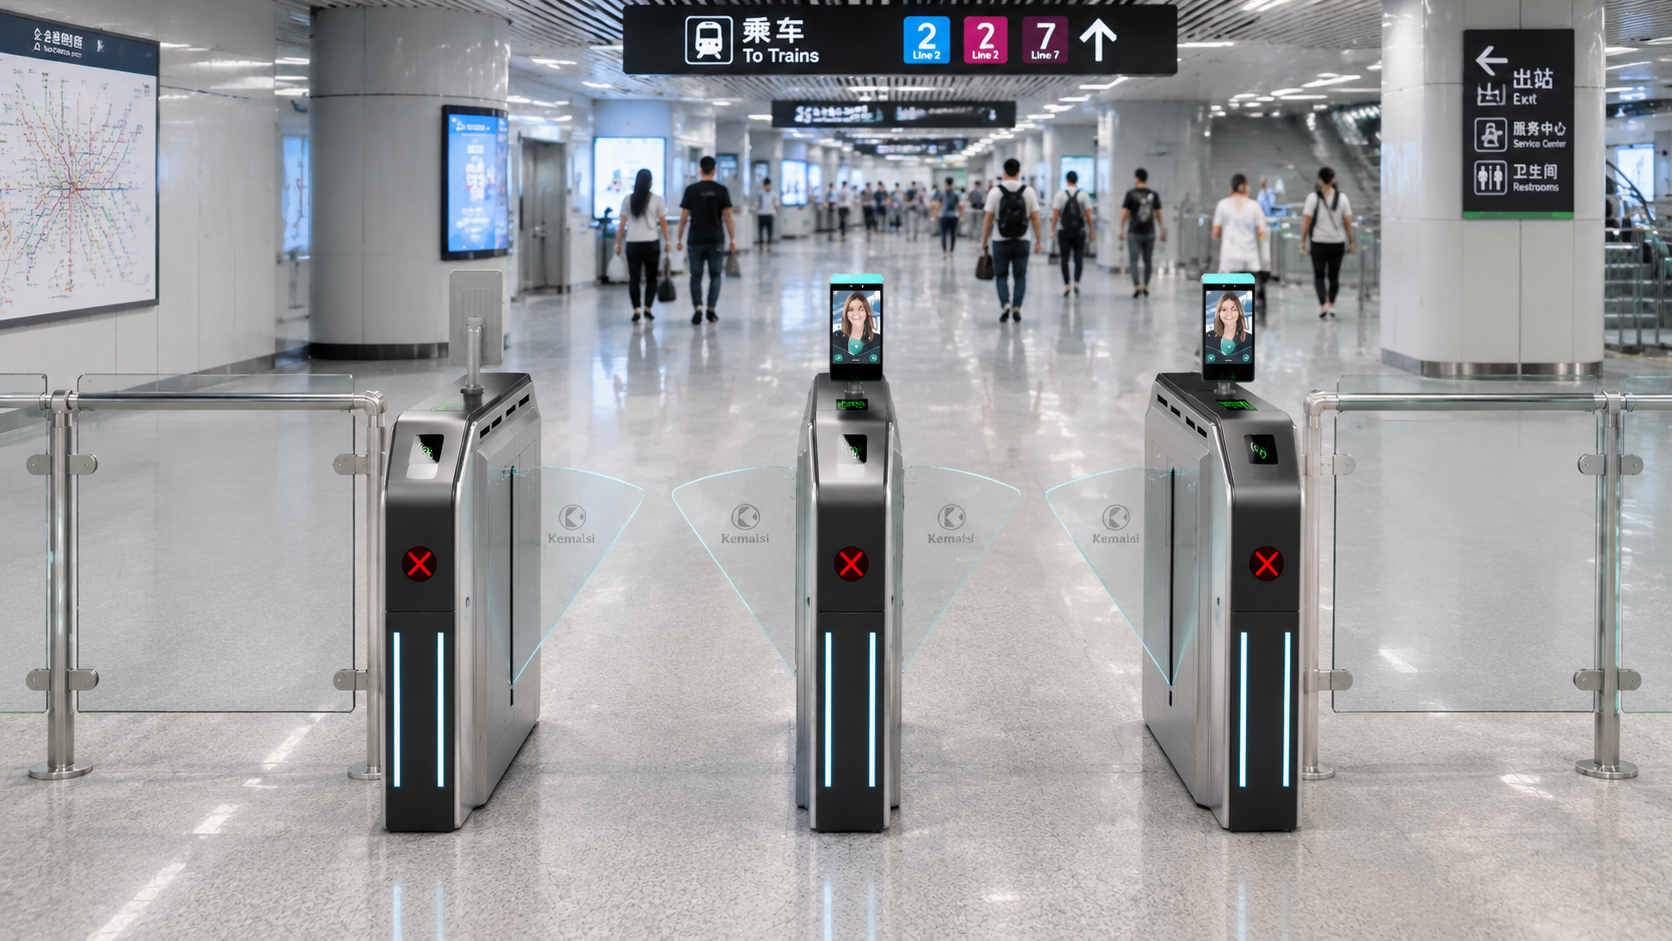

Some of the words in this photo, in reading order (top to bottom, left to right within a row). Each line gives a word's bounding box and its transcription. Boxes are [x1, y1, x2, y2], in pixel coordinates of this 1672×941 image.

[742, 16, 804, 44] 乘车
[917, 22, 937, 50] 2
[976, 22, 995, 50] 2
[1036, 22, 1056, 50] 7
[742, 48, 763, 63] To
[767, 48, 820, 63] Trains
[912, 51, 933, 60] Line
[934, 51, 941, 60] 2
[972, 51, 992, 60] Line
[993, 50, 999, 60] 2
[1031, 51, 1052, 60] Line
[1053, 51, 1060, 60] 7
[1513, 67, 1554, 89] 出站
[1513, 92, 1537, 105] Exit
[1513, 121, 1566, 136] 服务中心
[1513, 139, 1541, 148] Service
[1542, 139, 1566, 148] Center
[1513, 163, 1558, 180] 卫生间
[1513, 182, 1559, 192] Restrooms
